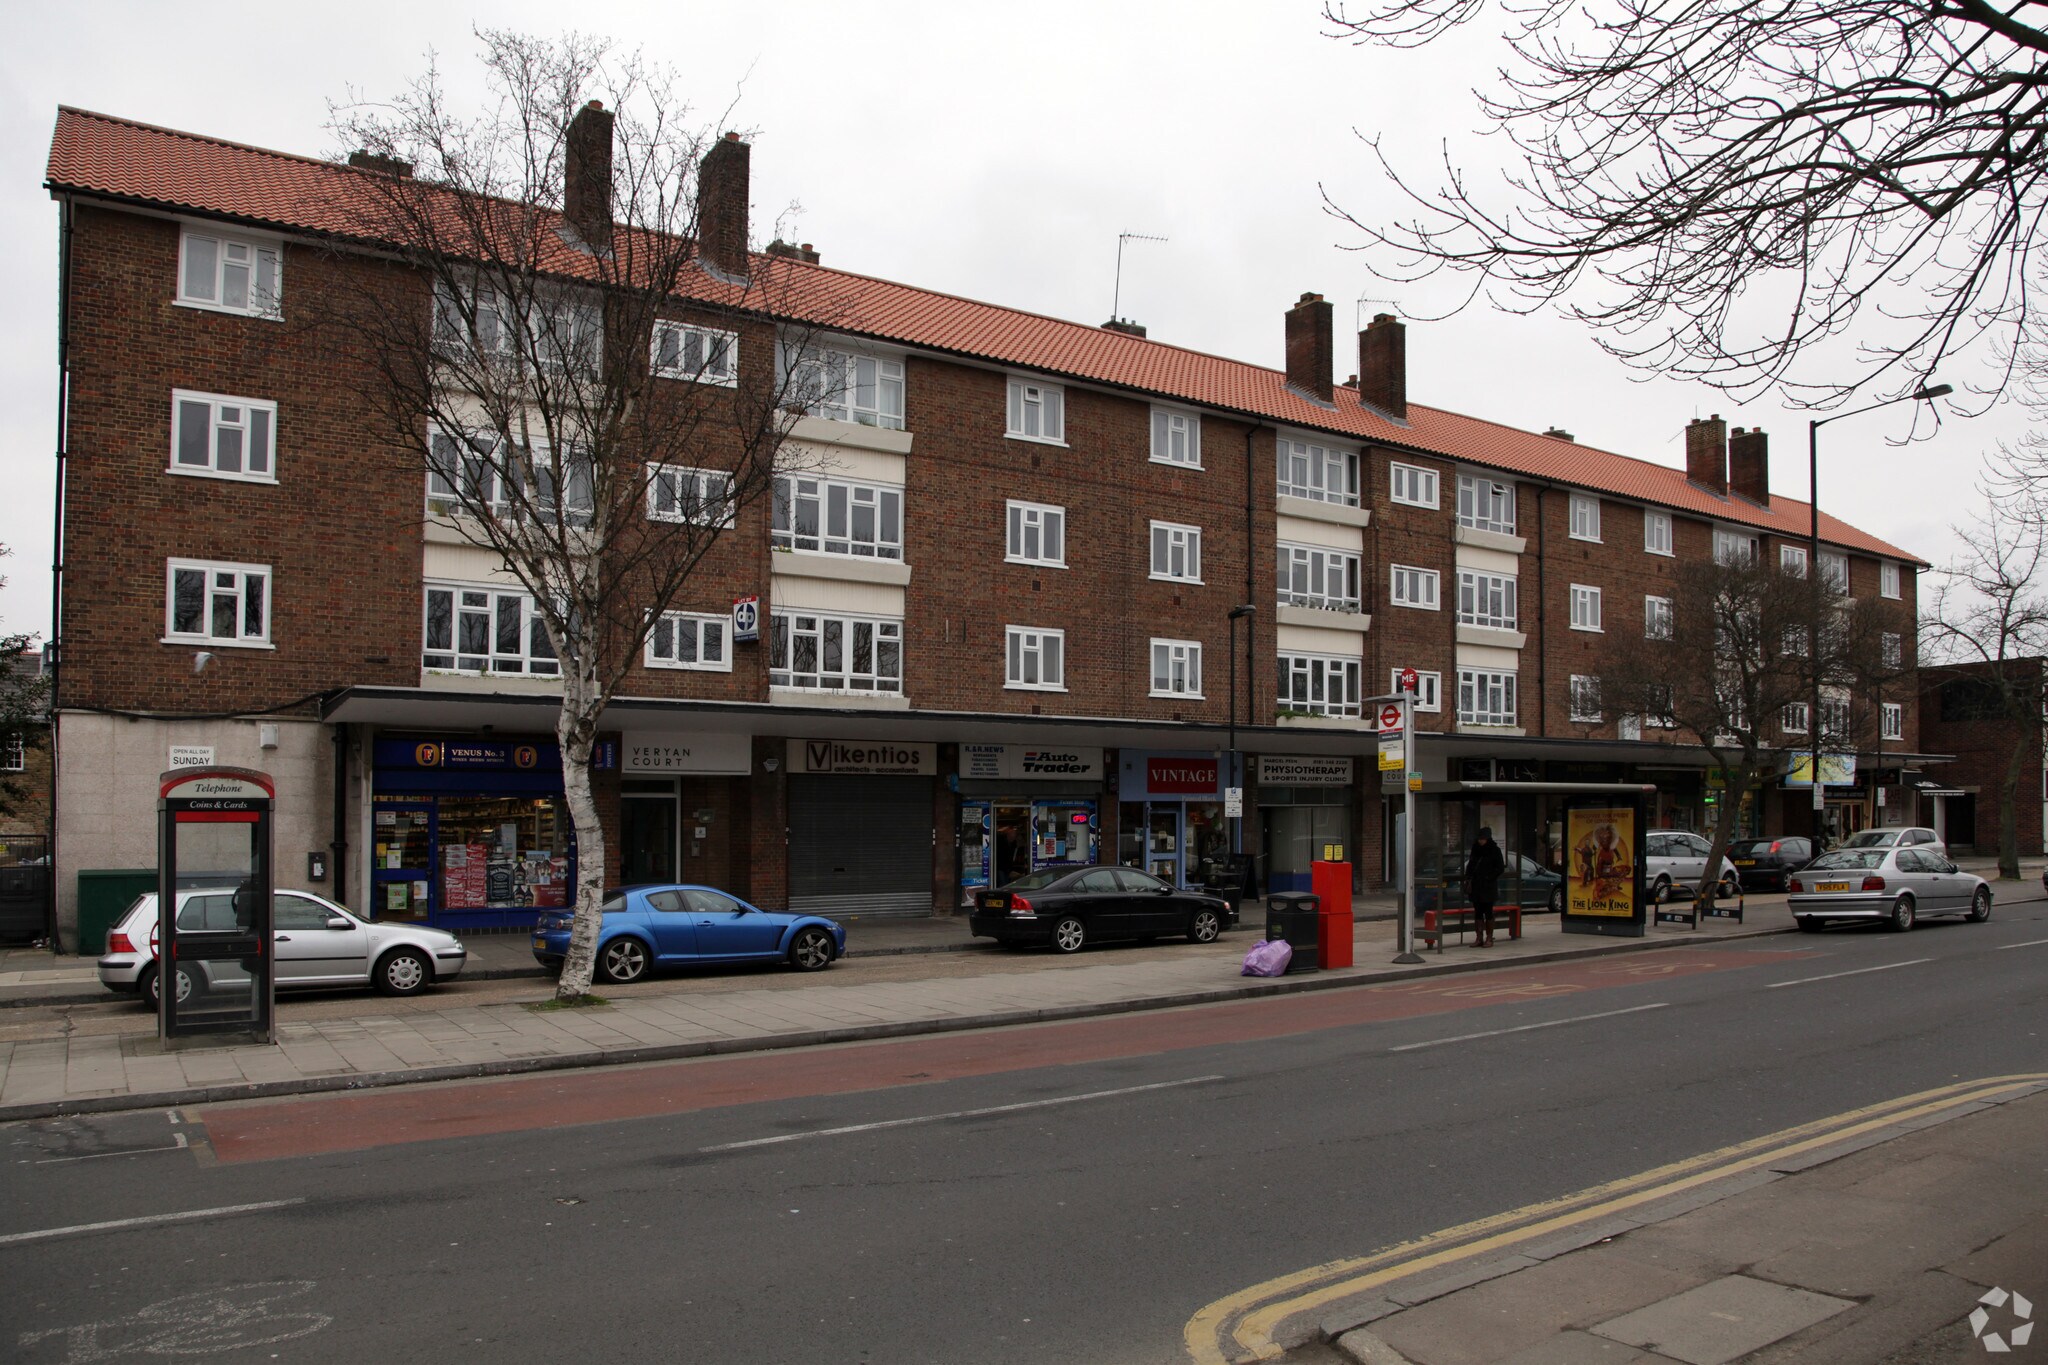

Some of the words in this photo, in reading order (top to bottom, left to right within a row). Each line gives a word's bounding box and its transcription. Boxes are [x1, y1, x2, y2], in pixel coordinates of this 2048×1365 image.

[1401, 673, 1414, 683] ME
[451, 749, 482, 757] VENUS
[632, 747, 691, 757] VERYAN
[810, 744, 920, 768] Vikentios
[1037, 752, 1079, 762] Auto
[173, 756, 210, 765] SUNDAY
[632, 757, 683, 767] COURT
[1023, 762, 1090, 773] Trader
[1264, 765, 1347, 775] PHYSIOTHERAPY
[1152, 769, 1216, 782] VINTAGE
[195, 784, 242, 794] Telephone
[189, 801, 213, 809] Coins
[214, 801, 221, 809] &
[223, 801, 248, 809] Cards
[1572, 900, 1586, 908] THE
[1587, 898, 1606, 911] LION
[1608, 898, 1629, 911] KING
